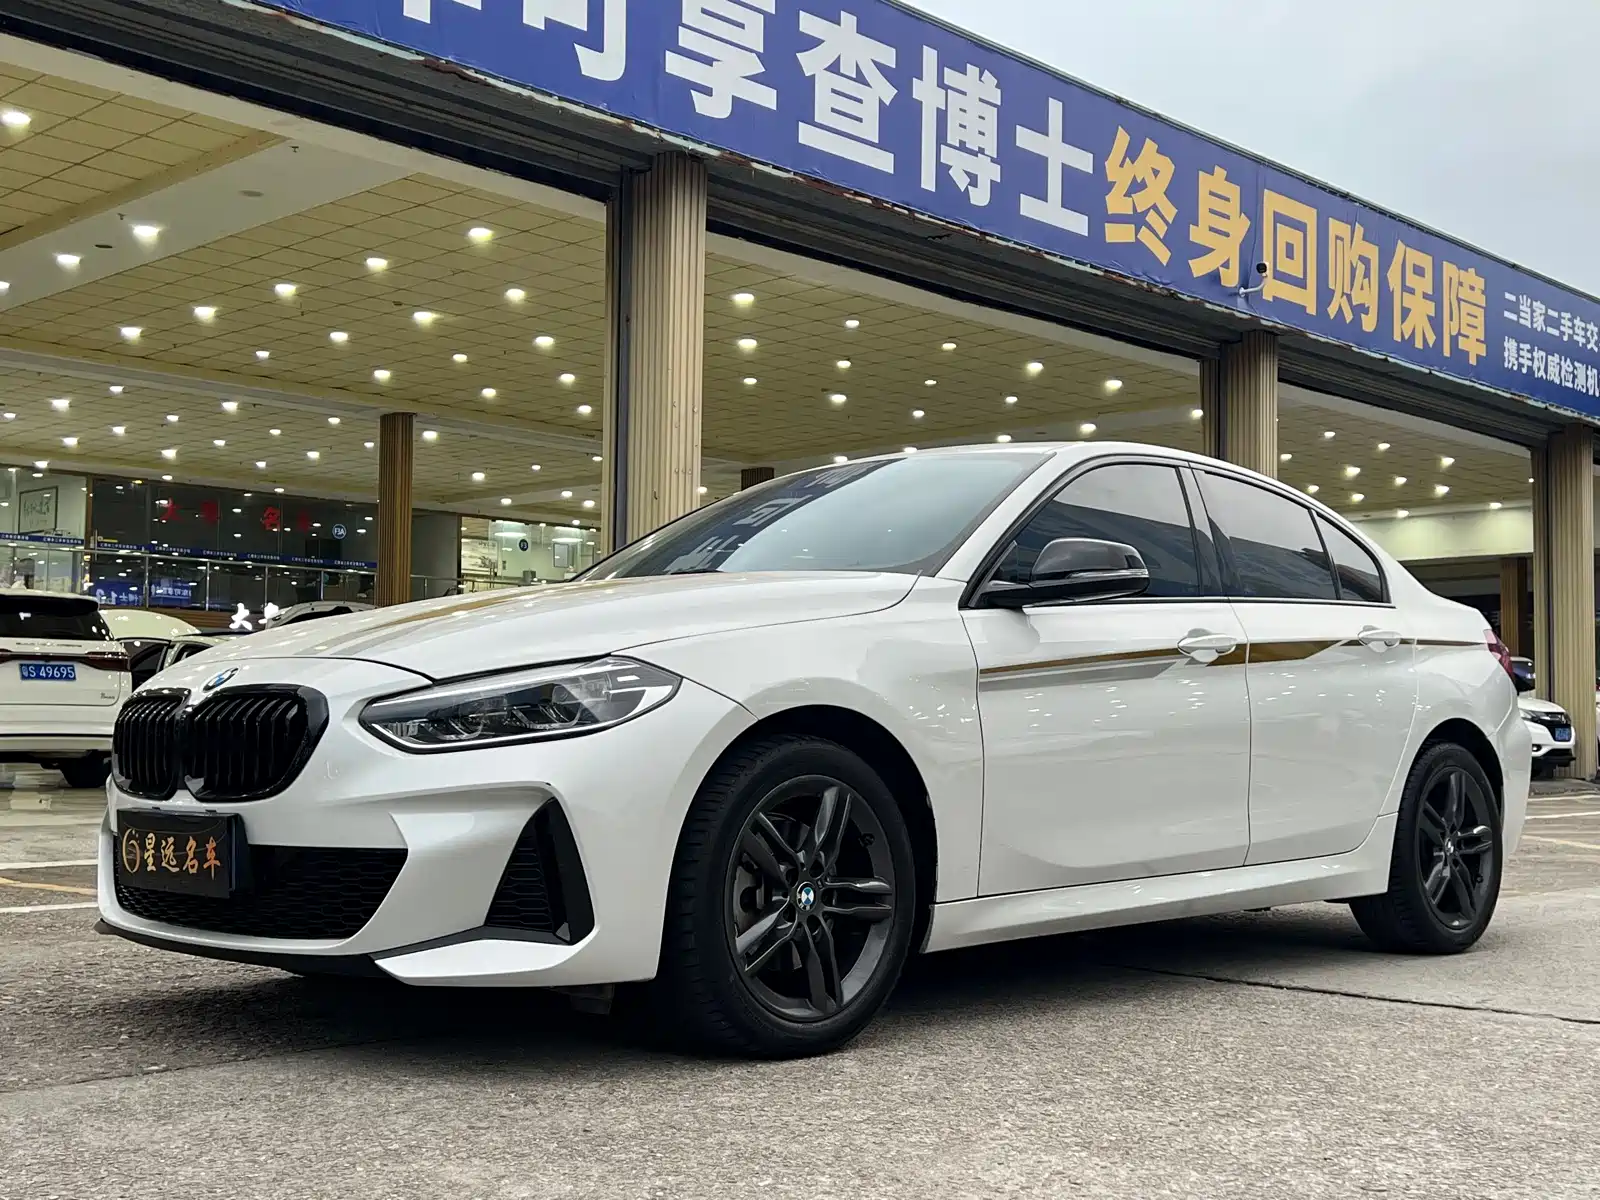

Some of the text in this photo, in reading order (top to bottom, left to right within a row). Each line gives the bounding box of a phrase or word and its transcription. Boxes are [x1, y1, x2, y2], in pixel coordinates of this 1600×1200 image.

[402, 0, 1486, 365] 可享查博士终身回购保障
[1503, 291, 1600, 352] 二当家二手车交
[1503, 335, 1600, 398] 携手权威检测机
[39, 666, 75, 679] 49695
